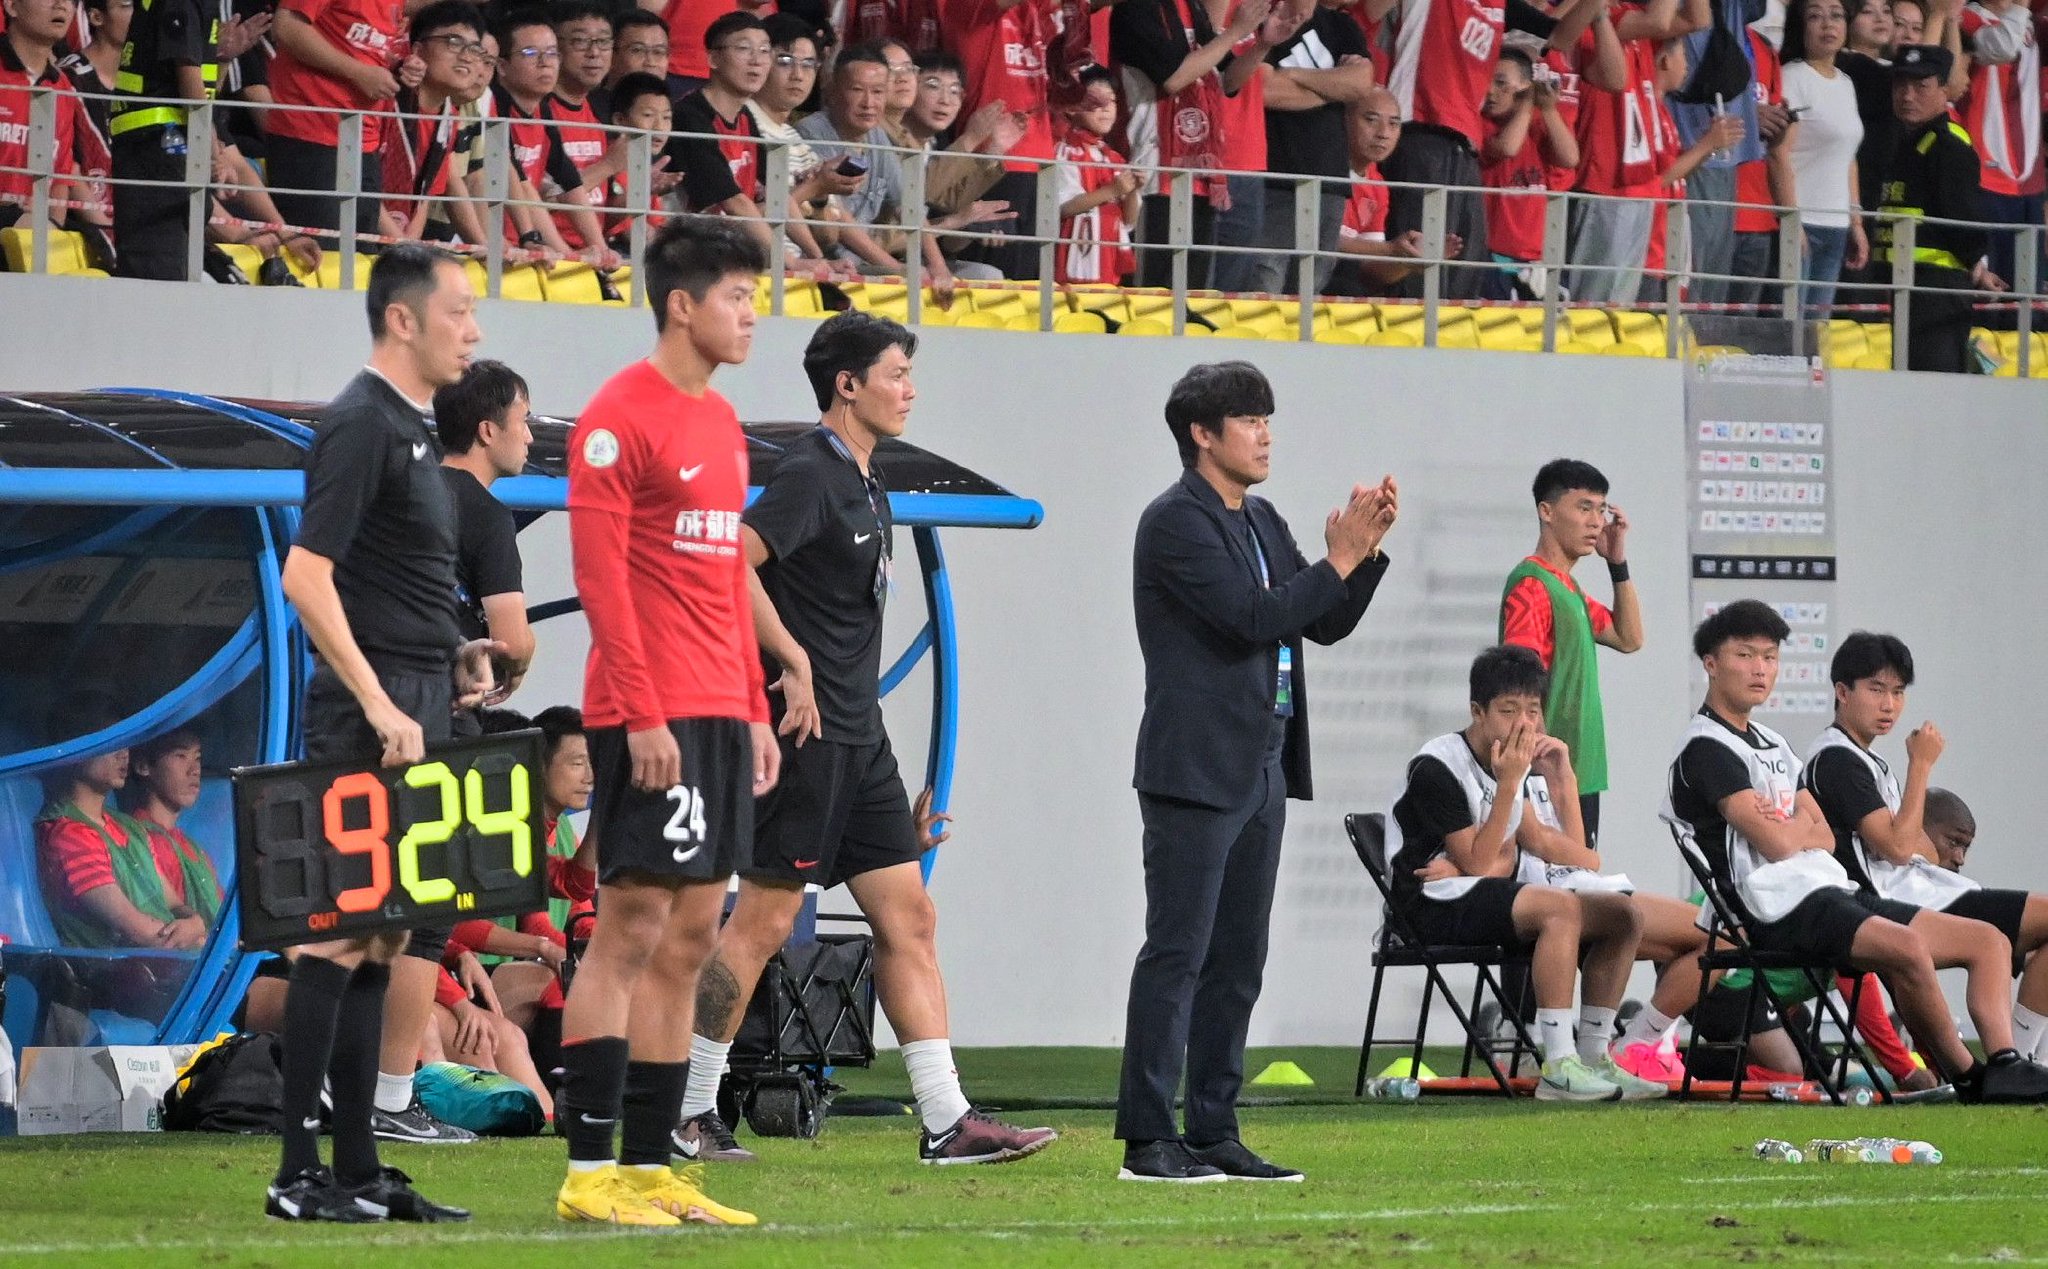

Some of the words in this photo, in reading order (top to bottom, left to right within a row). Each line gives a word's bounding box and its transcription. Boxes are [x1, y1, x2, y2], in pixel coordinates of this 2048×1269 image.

[323, 771, 391, 913] 9
[397, 761, 532, 904] 24
[662, 784, 707, 842] 24
[308, 911, 338, 930] OUT
[456, 892, 475, 911] IN
